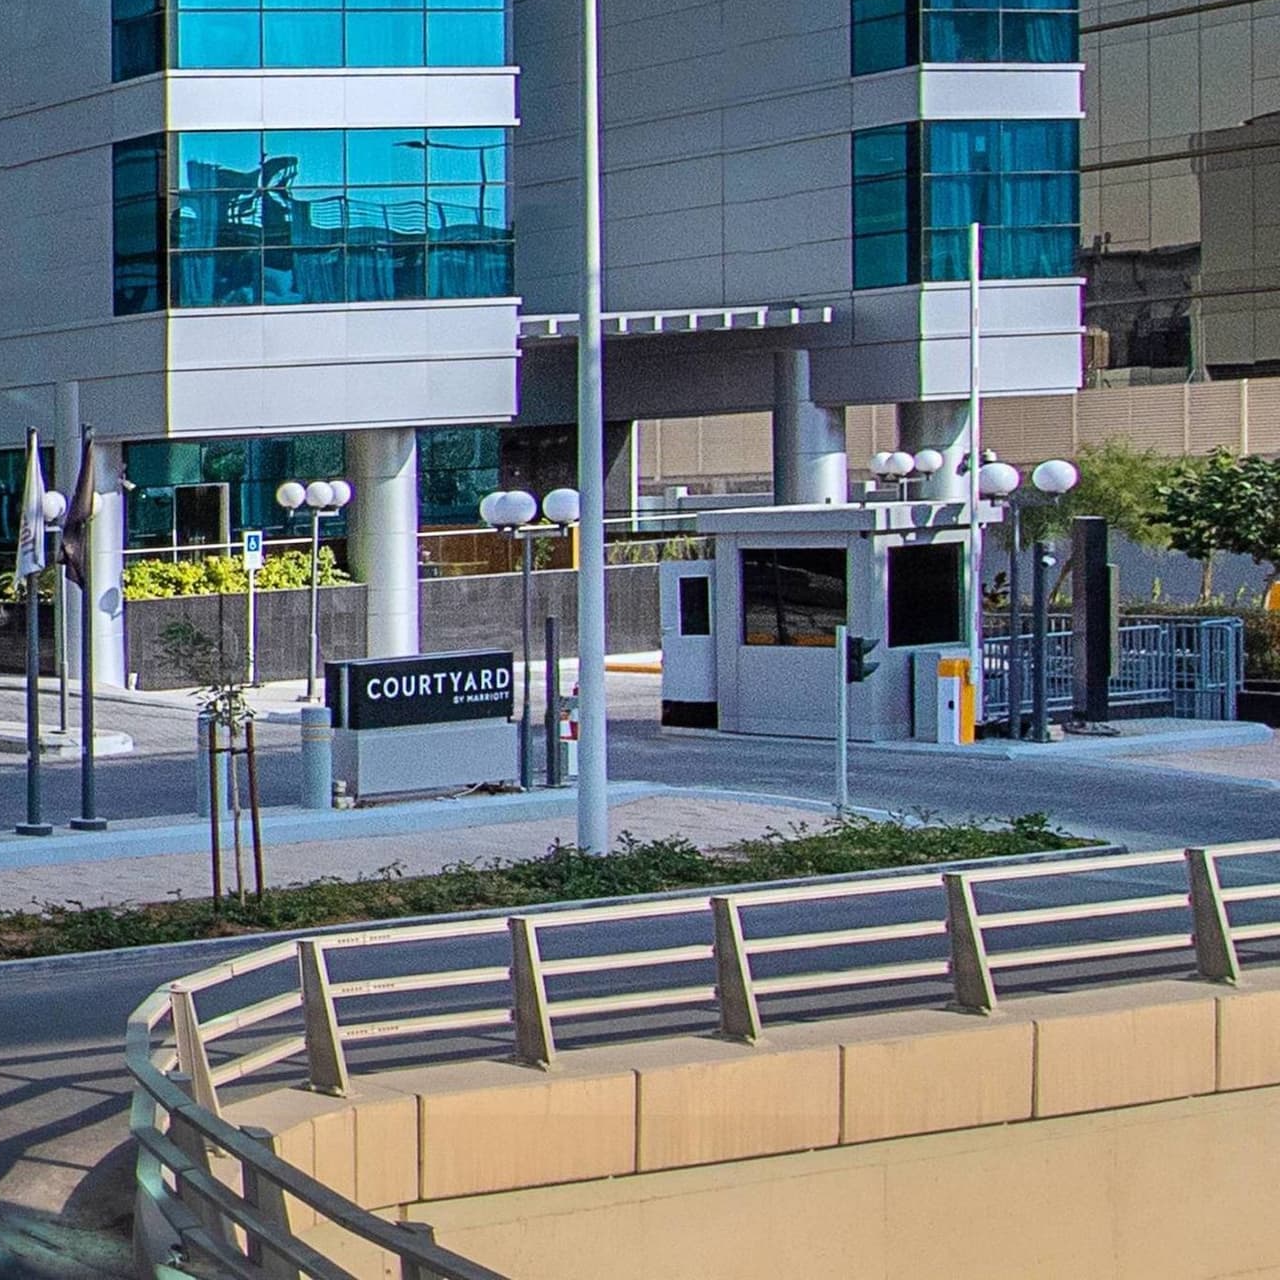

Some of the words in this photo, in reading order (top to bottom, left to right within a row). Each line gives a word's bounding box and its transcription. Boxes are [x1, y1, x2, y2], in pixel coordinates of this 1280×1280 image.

[366, 668, 510, 700] COURTYARD
[452, 695, 464, 705] BY
[466, 691, 510, 703] MARRIOTT
